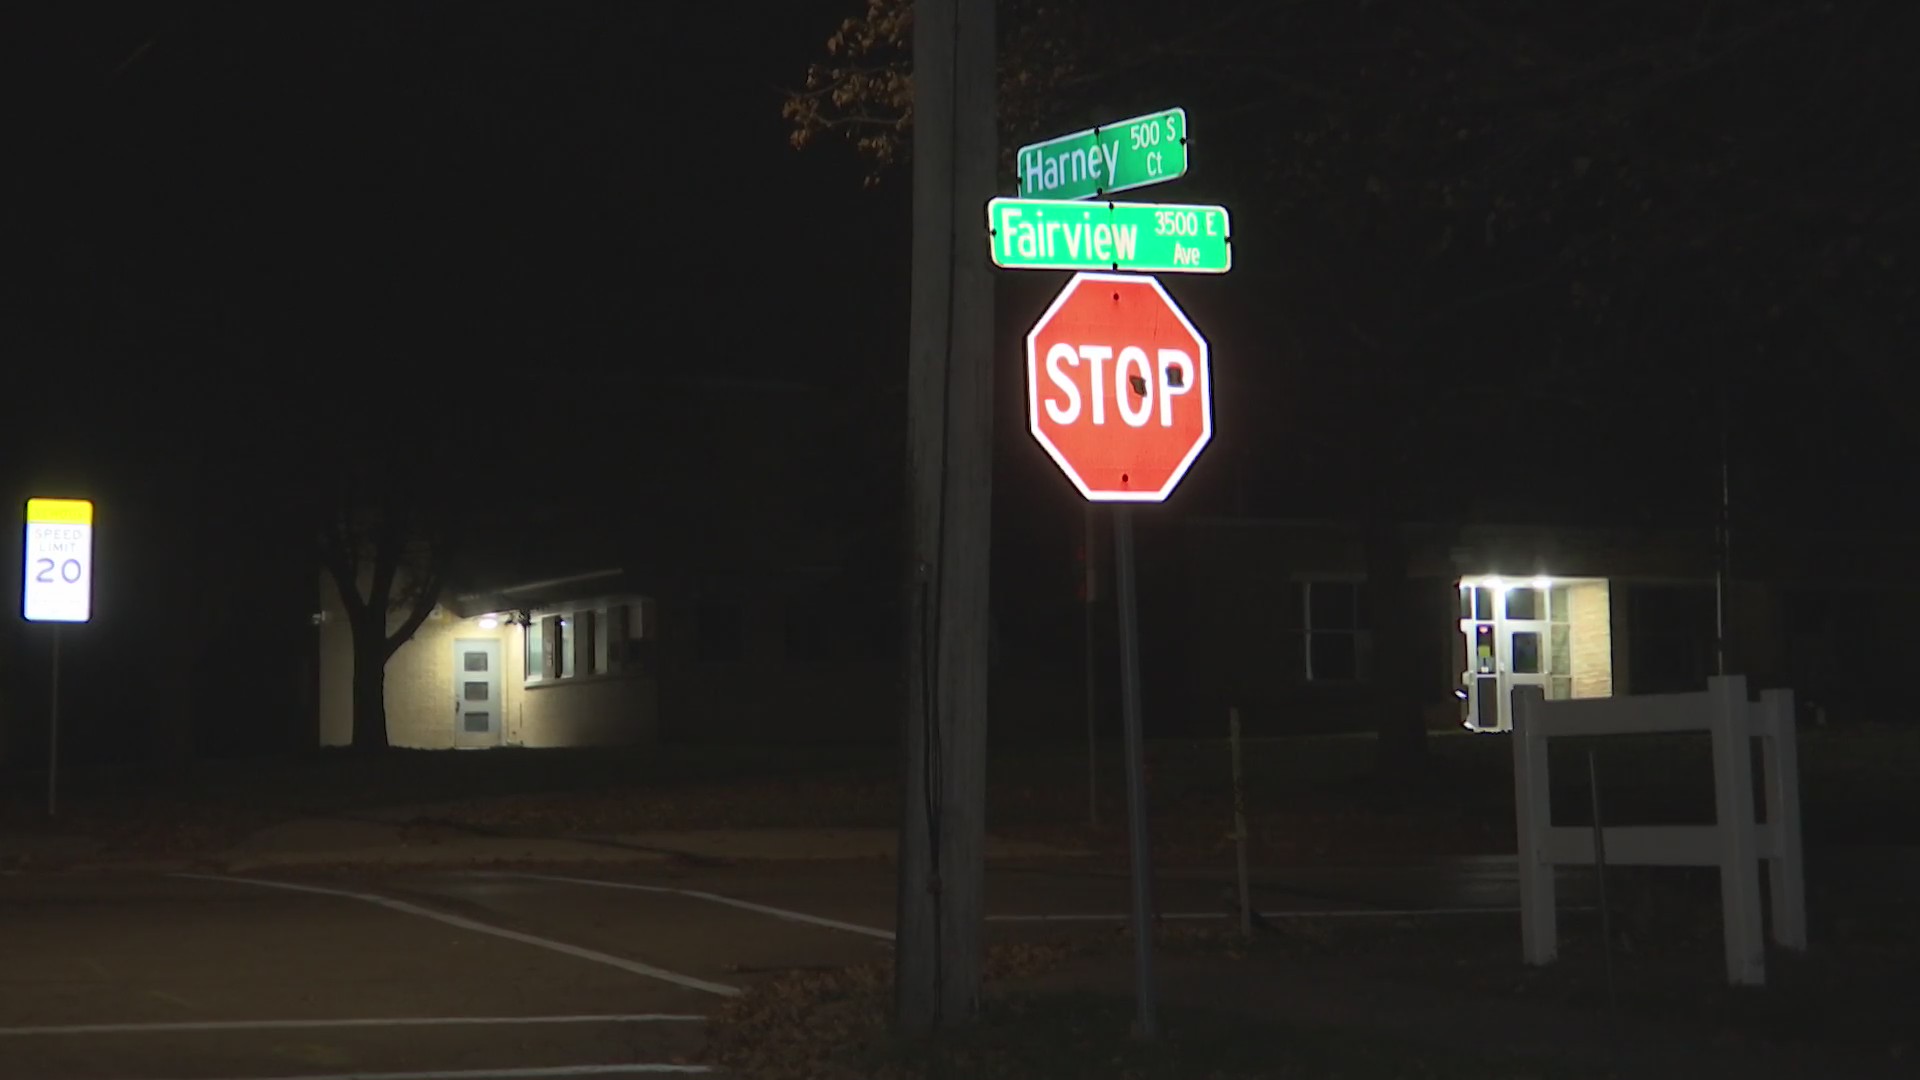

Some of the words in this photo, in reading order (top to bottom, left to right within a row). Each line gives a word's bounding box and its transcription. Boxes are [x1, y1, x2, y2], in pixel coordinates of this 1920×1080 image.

[1130, 120, 1160, 151] 500
[1166, 116, 1176, 142] S
[1025, 139, 1120, 194] Harney
[1146, 151, 1163, 177] Ct
[1001, 208, 1137, 261] Fairview
[1154, 211, 1198, 236] 3500
[1206, 212, 1217, 236] E
[1173, 241, 1201, 266] Ave
[1044, 342, 1194, 428] STOP
[35, 528, 82, 540] SPEED
[39, 543, 77, 552] LIMIT
[36, 557, 82, 584] 20
